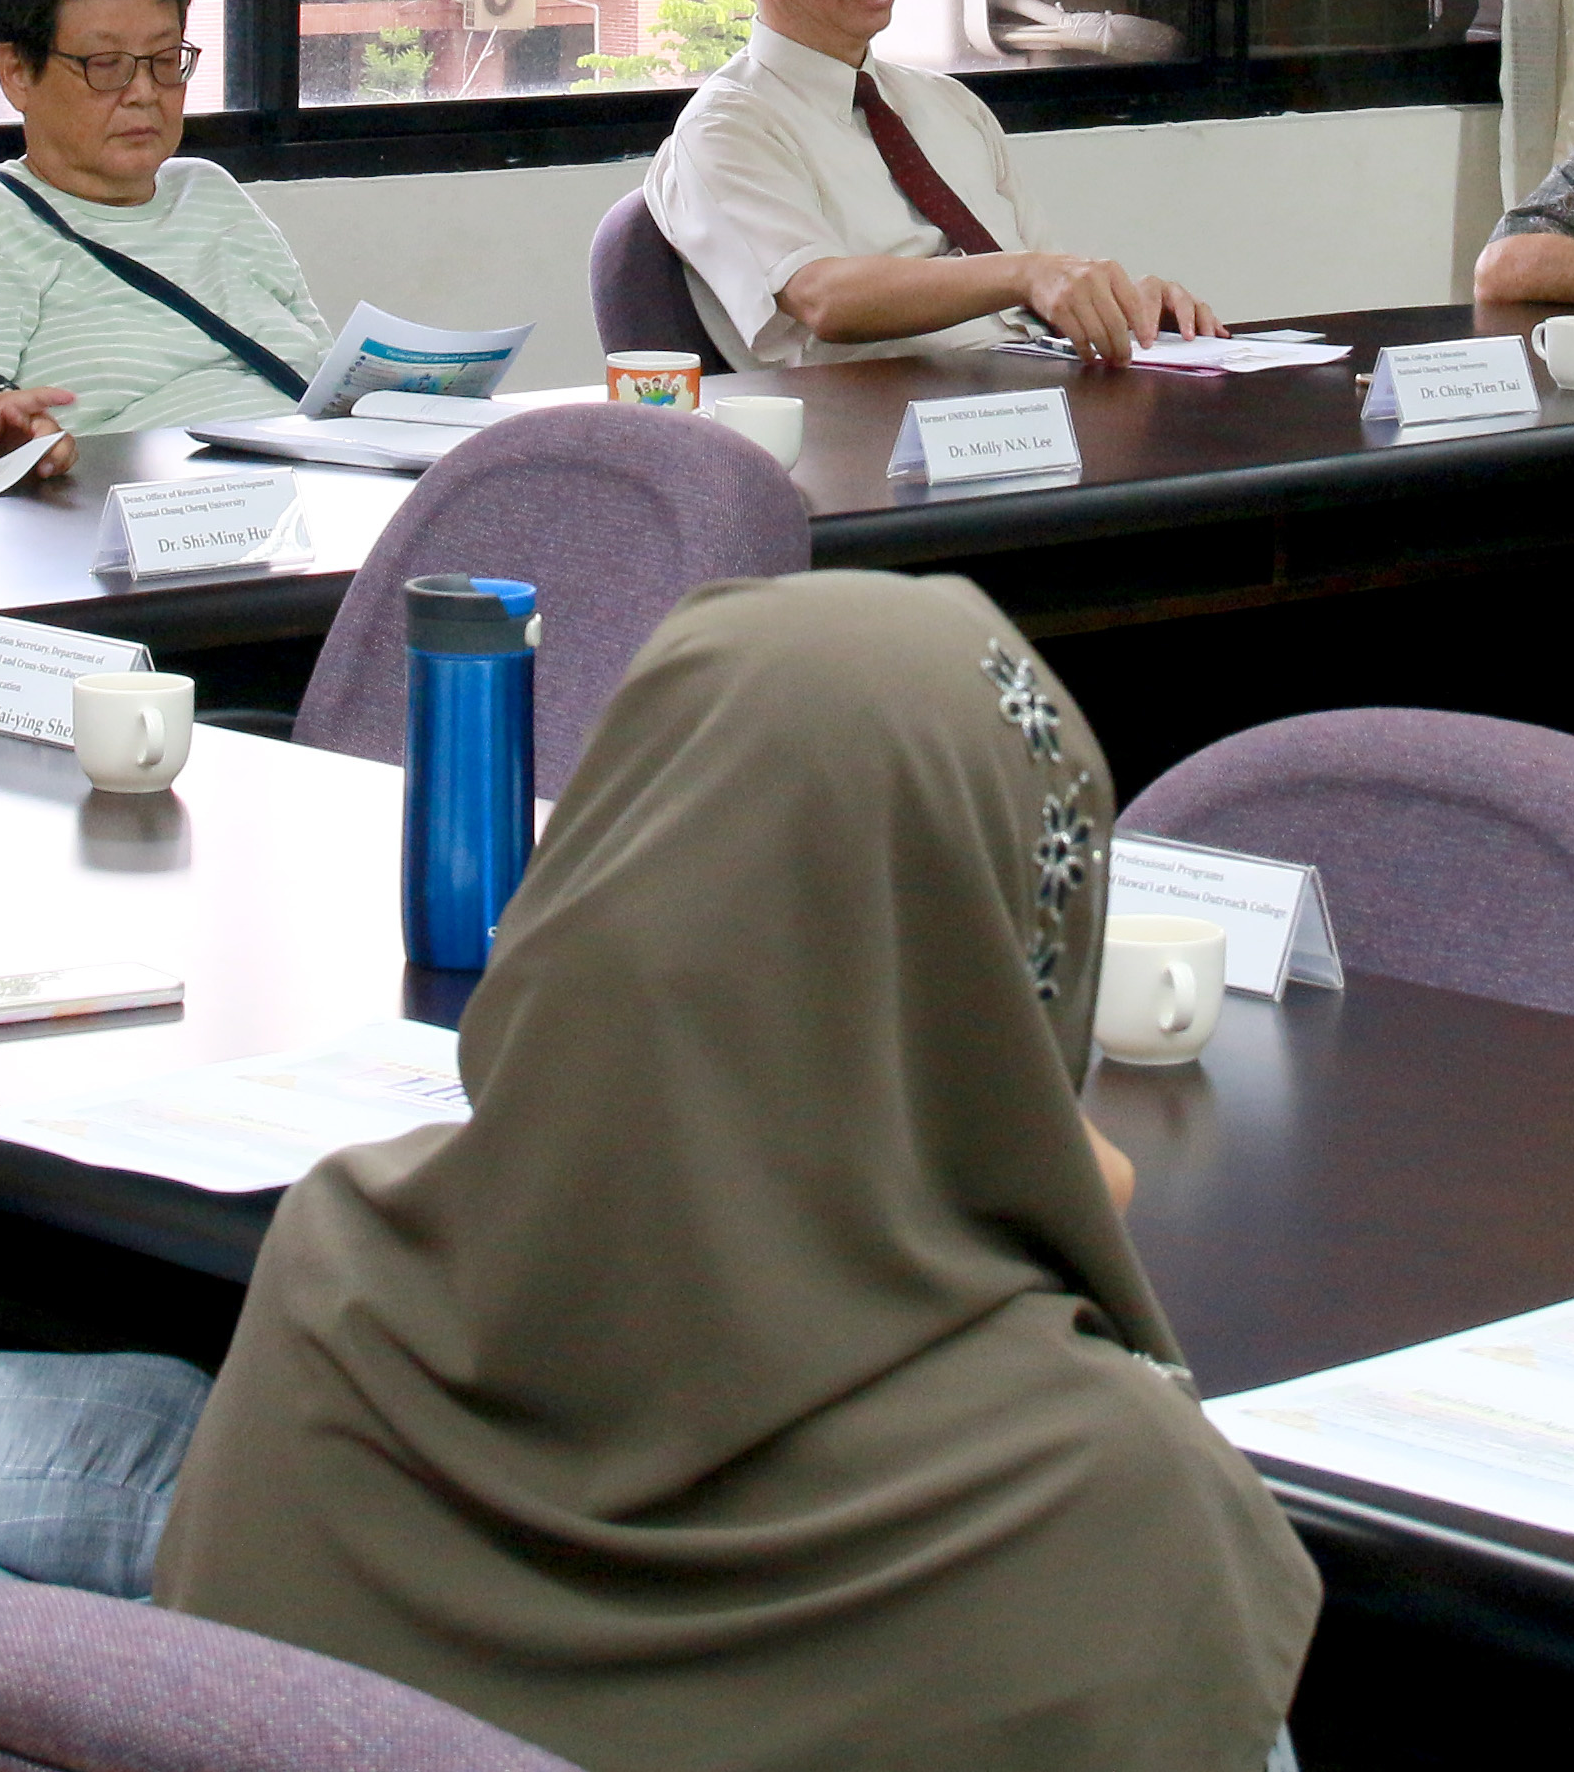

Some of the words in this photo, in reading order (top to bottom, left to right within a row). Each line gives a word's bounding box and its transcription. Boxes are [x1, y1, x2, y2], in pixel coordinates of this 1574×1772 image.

[1420, 387, 1438, 399] Dr.
[1439, 382, 1498, 398] Ching-Tien
[1500, 379, 1521, 392] Tsai
[949, 445, 968, 458] Dr.
[970, 440, 1003, 457] Molly
[1004, 438, 1030, 451] N.N.
[1033, 435, 1053, 448] Lee
[158, 538, 181, 553] Dr.
[183, 532, 245, 549] Shi-Ming
[96, 655, 105, 666] of
